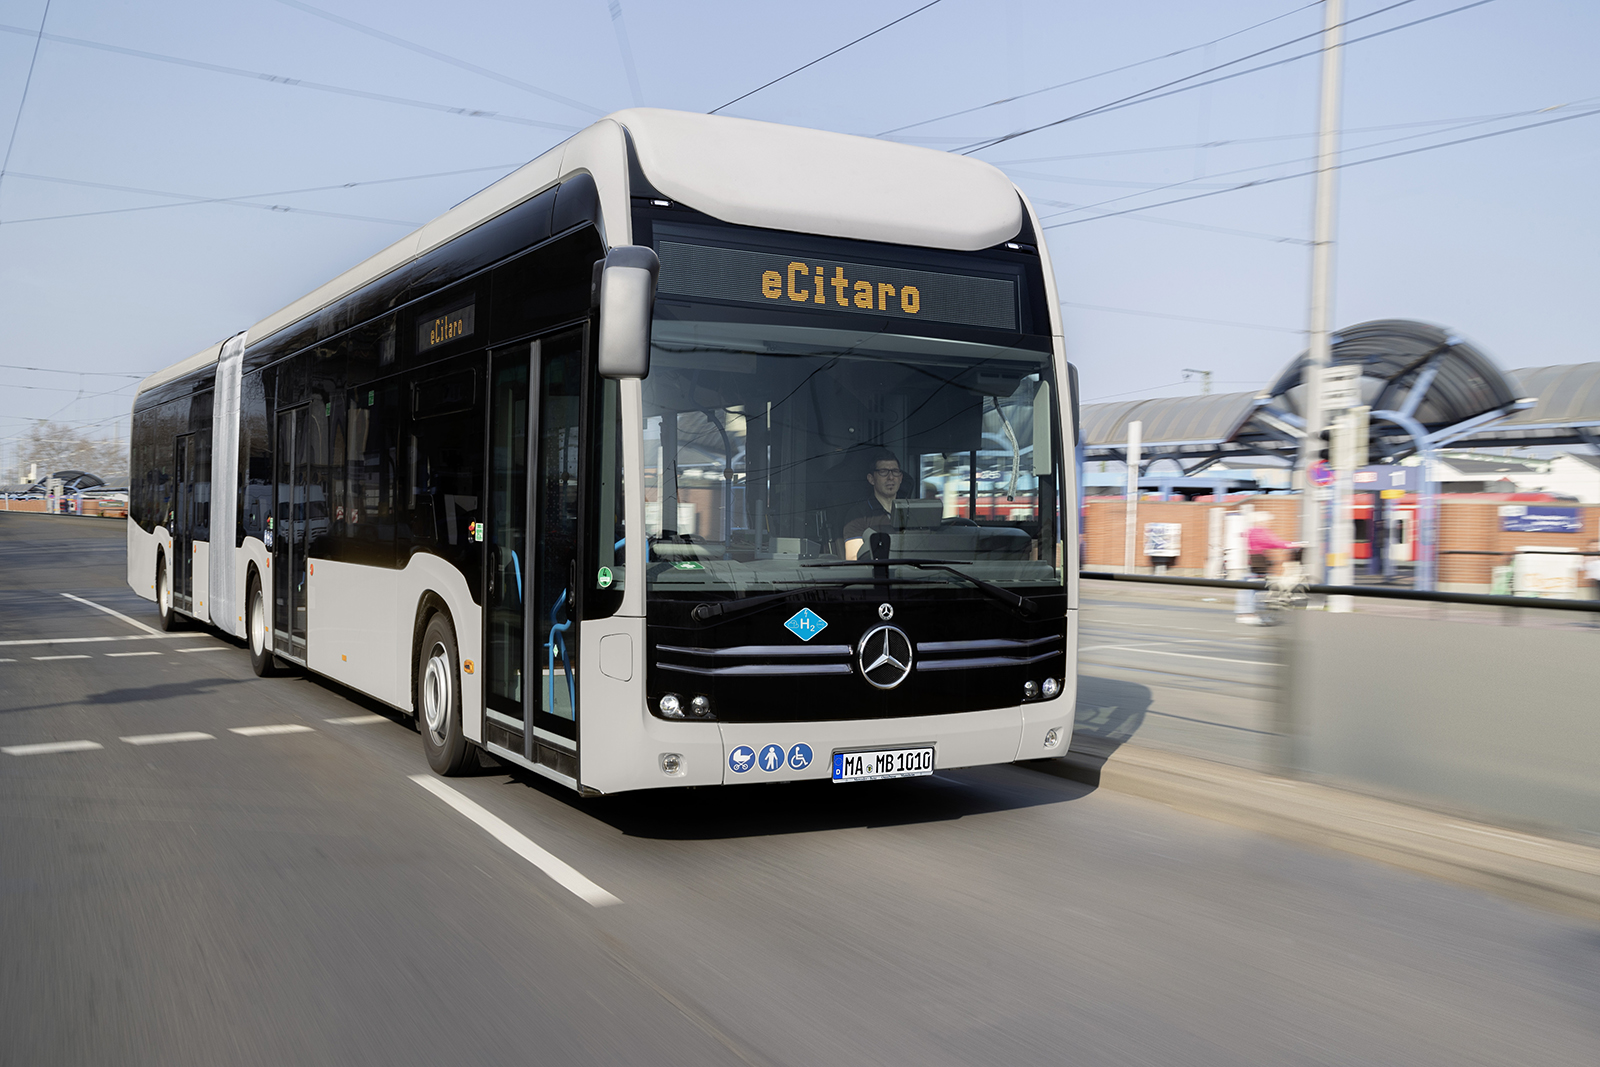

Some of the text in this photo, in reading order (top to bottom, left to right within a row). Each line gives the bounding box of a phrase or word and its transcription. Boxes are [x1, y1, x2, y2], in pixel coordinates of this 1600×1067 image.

[762, 262, 920, 314] eCitaro
[430, 316, 463, 345] eCitaro
[845, 756, 863, 776] MA
